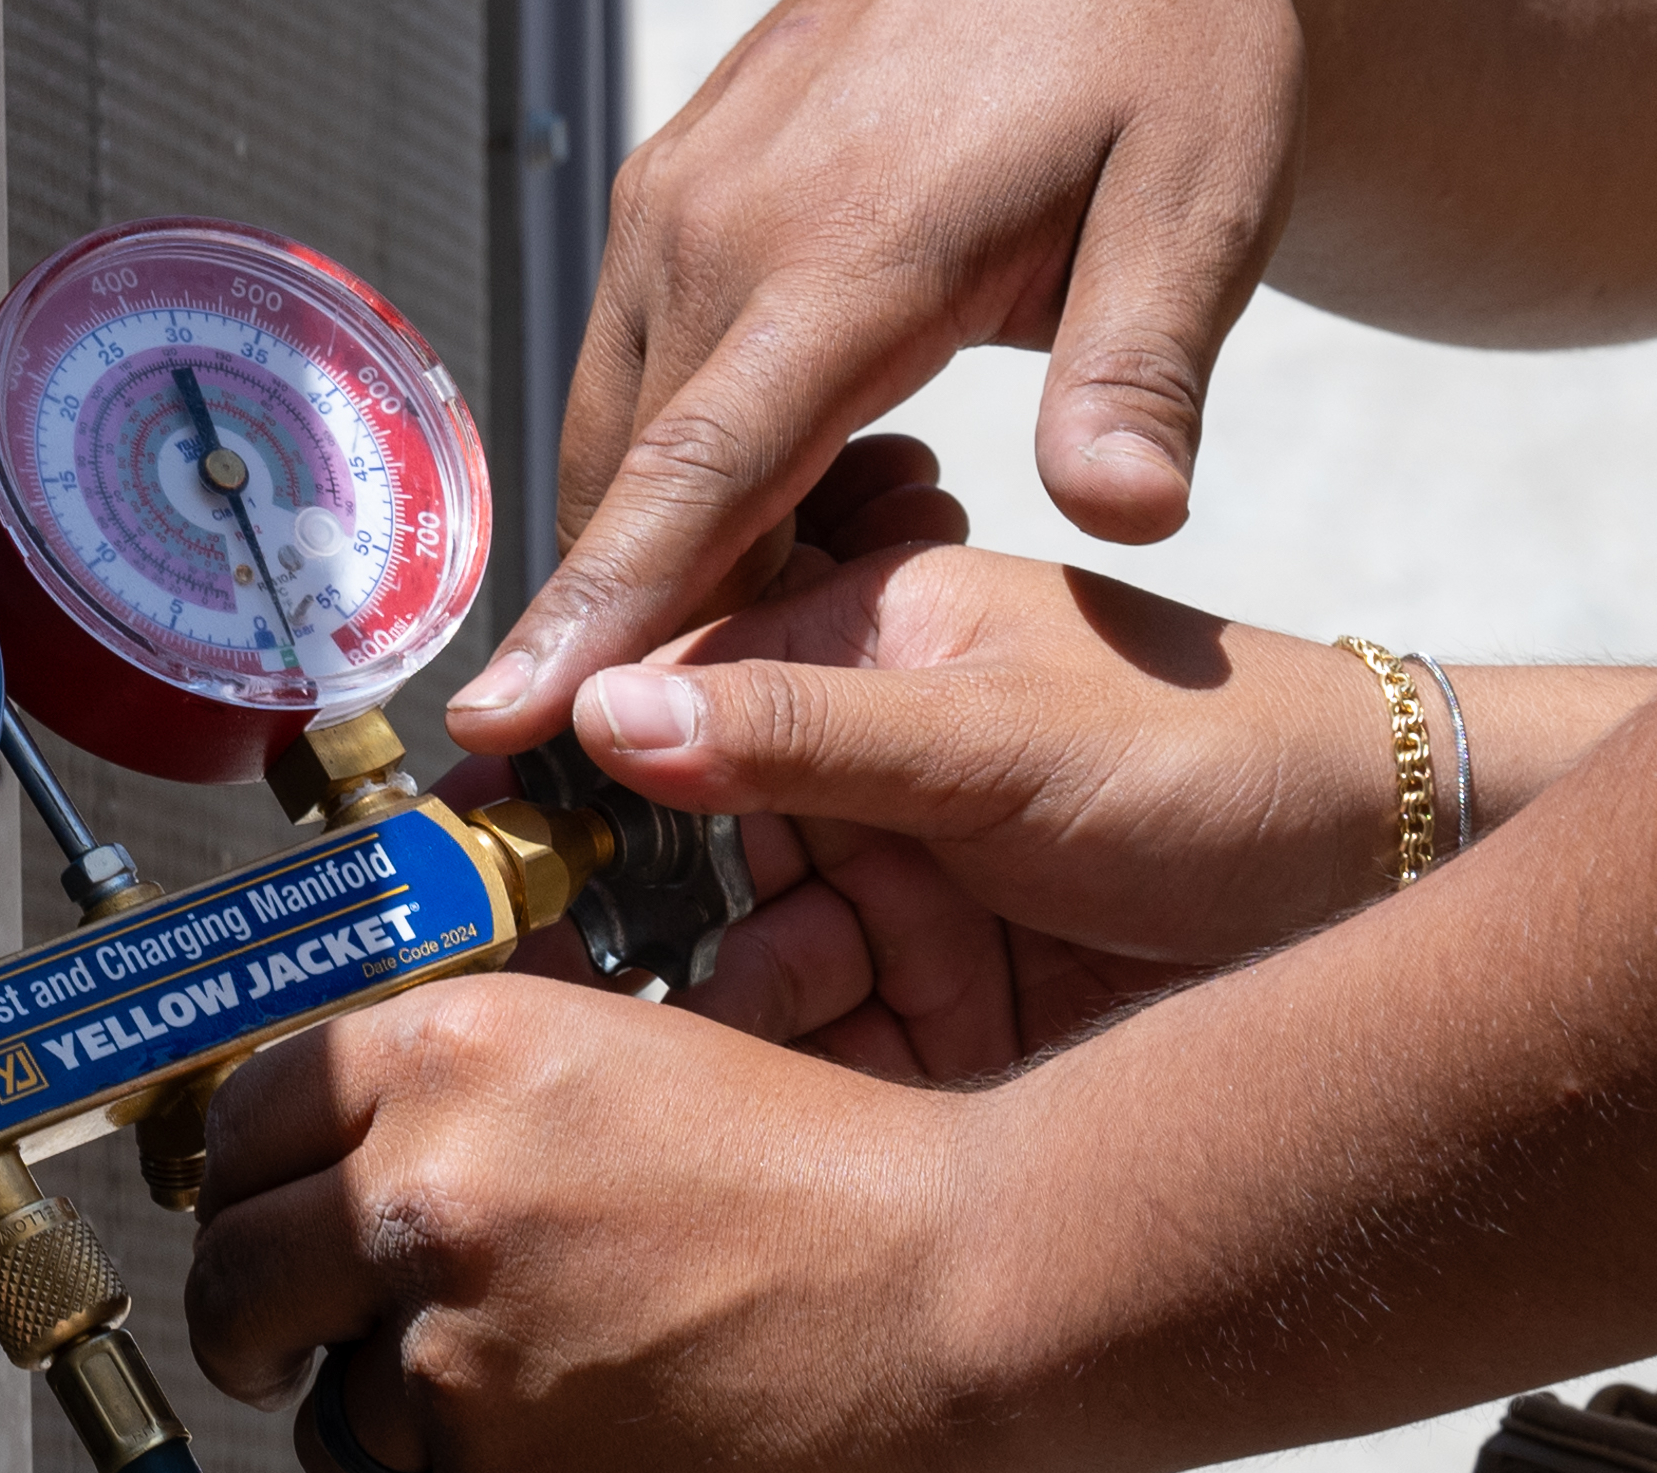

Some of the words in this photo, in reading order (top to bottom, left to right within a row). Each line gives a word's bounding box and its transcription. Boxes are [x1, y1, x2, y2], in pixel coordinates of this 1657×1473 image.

[90, 267, 139, 297] 400
[230, 277, 283, 313] 500
[164, 328, 193, 344] 30
[97, 342, 125, 366] 25
[240, 343, 269, 364] 35
[307, 392, 332, 415] 40
[358, 365, 401, 416] 600
[59, 395, 80, 423] 20
[60, 470, 78, 493] 15
[349, 456, 368, 483] 45
[353, 529, 373, 557] 50
[415, 511, 441, 559] 700
[95, 541, 117, 563] 10
[170, 599, 184, 614] 5
[316, 584, 342, 610] 55
[253, 616, 268, 631] 0
[347, 629, 395, 667] 800
[29, 956, 98, 1009] and
[94, 905, 252, 981] Charging
[246, 841, 397, 925] Manifold
[361, 954, 398, 979] Date
[398, 939, 440, 965] Code
[439, 921, 479, 949] 2024
[40, 971, 240, 1071] YELLOW
